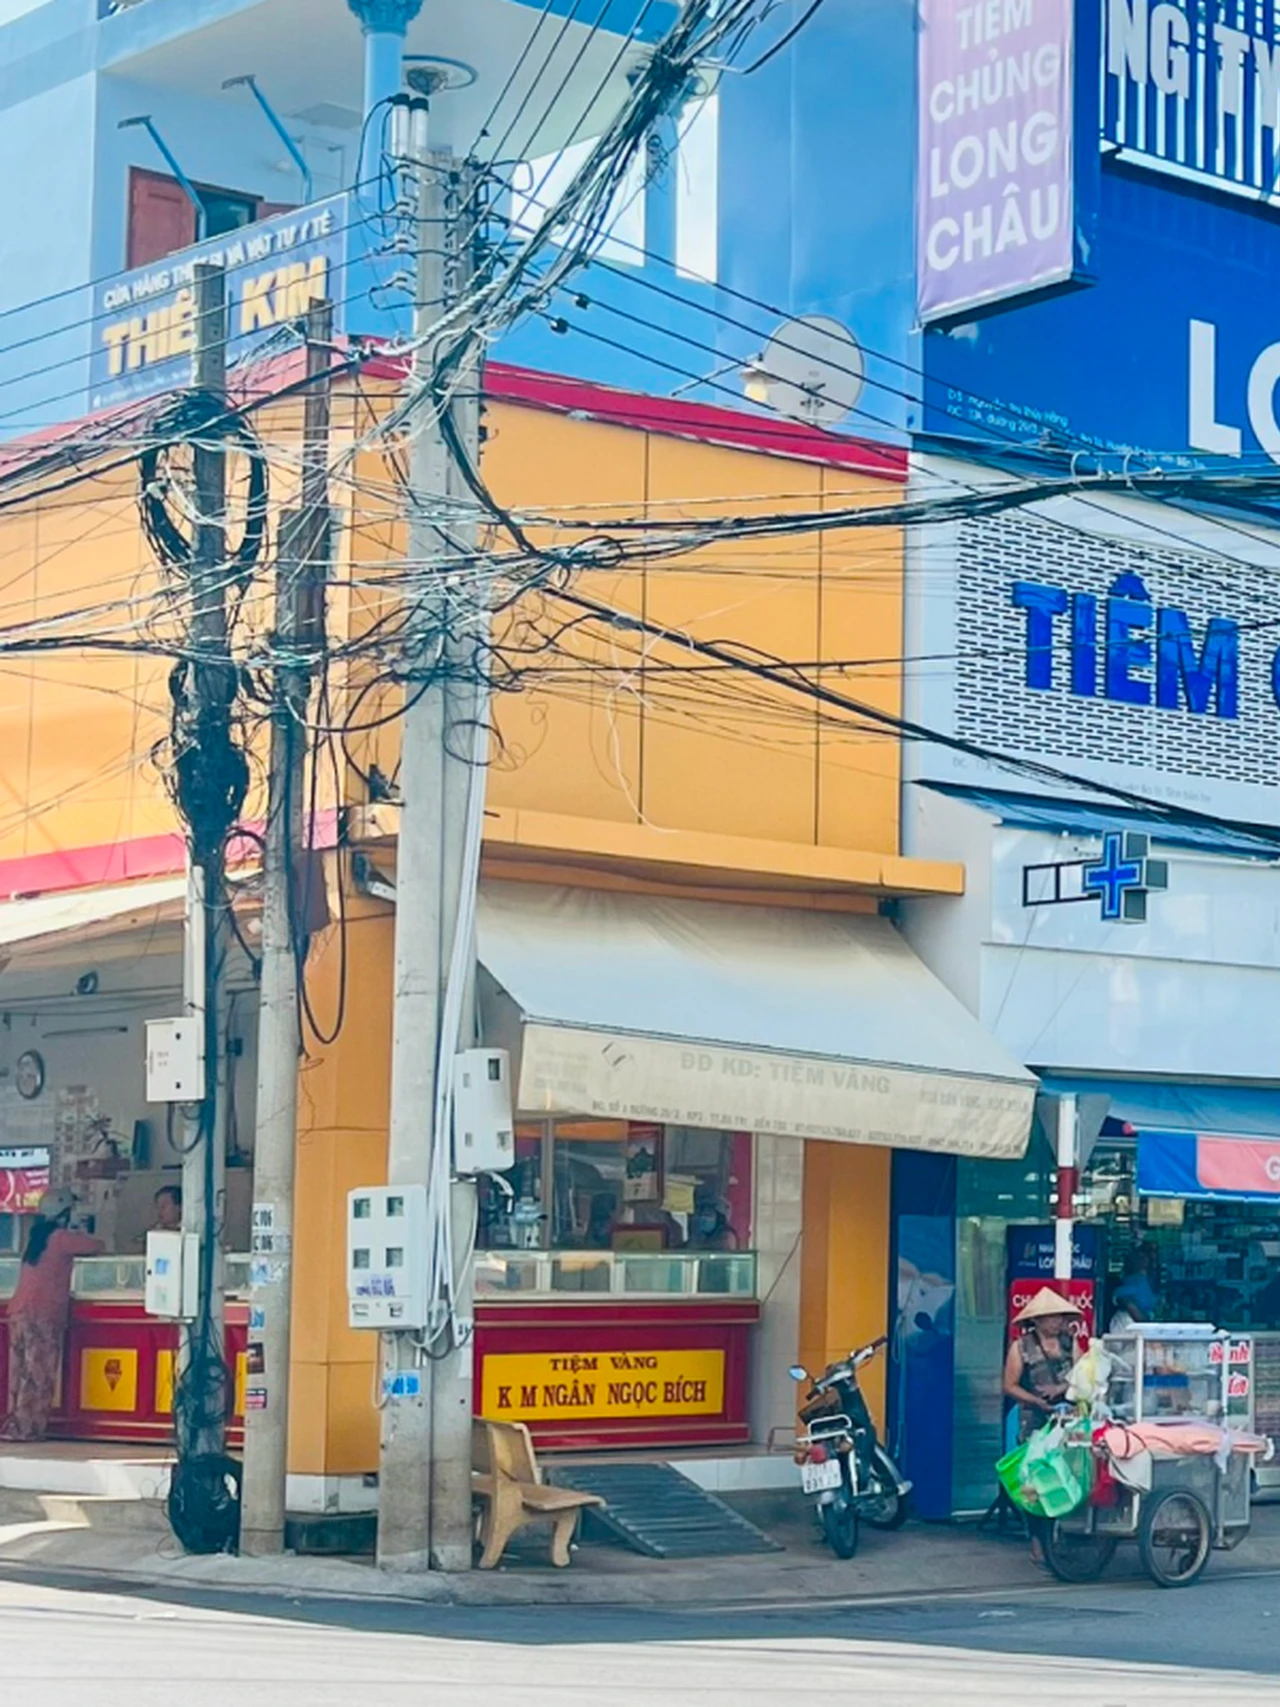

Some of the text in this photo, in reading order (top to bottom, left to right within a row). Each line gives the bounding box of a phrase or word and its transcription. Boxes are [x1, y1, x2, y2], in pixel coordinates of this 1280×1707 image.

[929, 44, 1060, 124] CHỦNG
[931, 111, 1058, 198] LONG
[926, 184, 1060, 271] CHÂU
[102, 255, 329, 376] THIÊ KIM
[132, 266, 171, 302] HÀNG
[1011, 570, 1239, 719] TIÊM
[832, 1067, 891, 1095] VÀNG
[497, 1375, 707, 1409] K M NGÂN NGỌC BÍCH
[549, 1352, 657, 1374] TIỆM VÀNG
